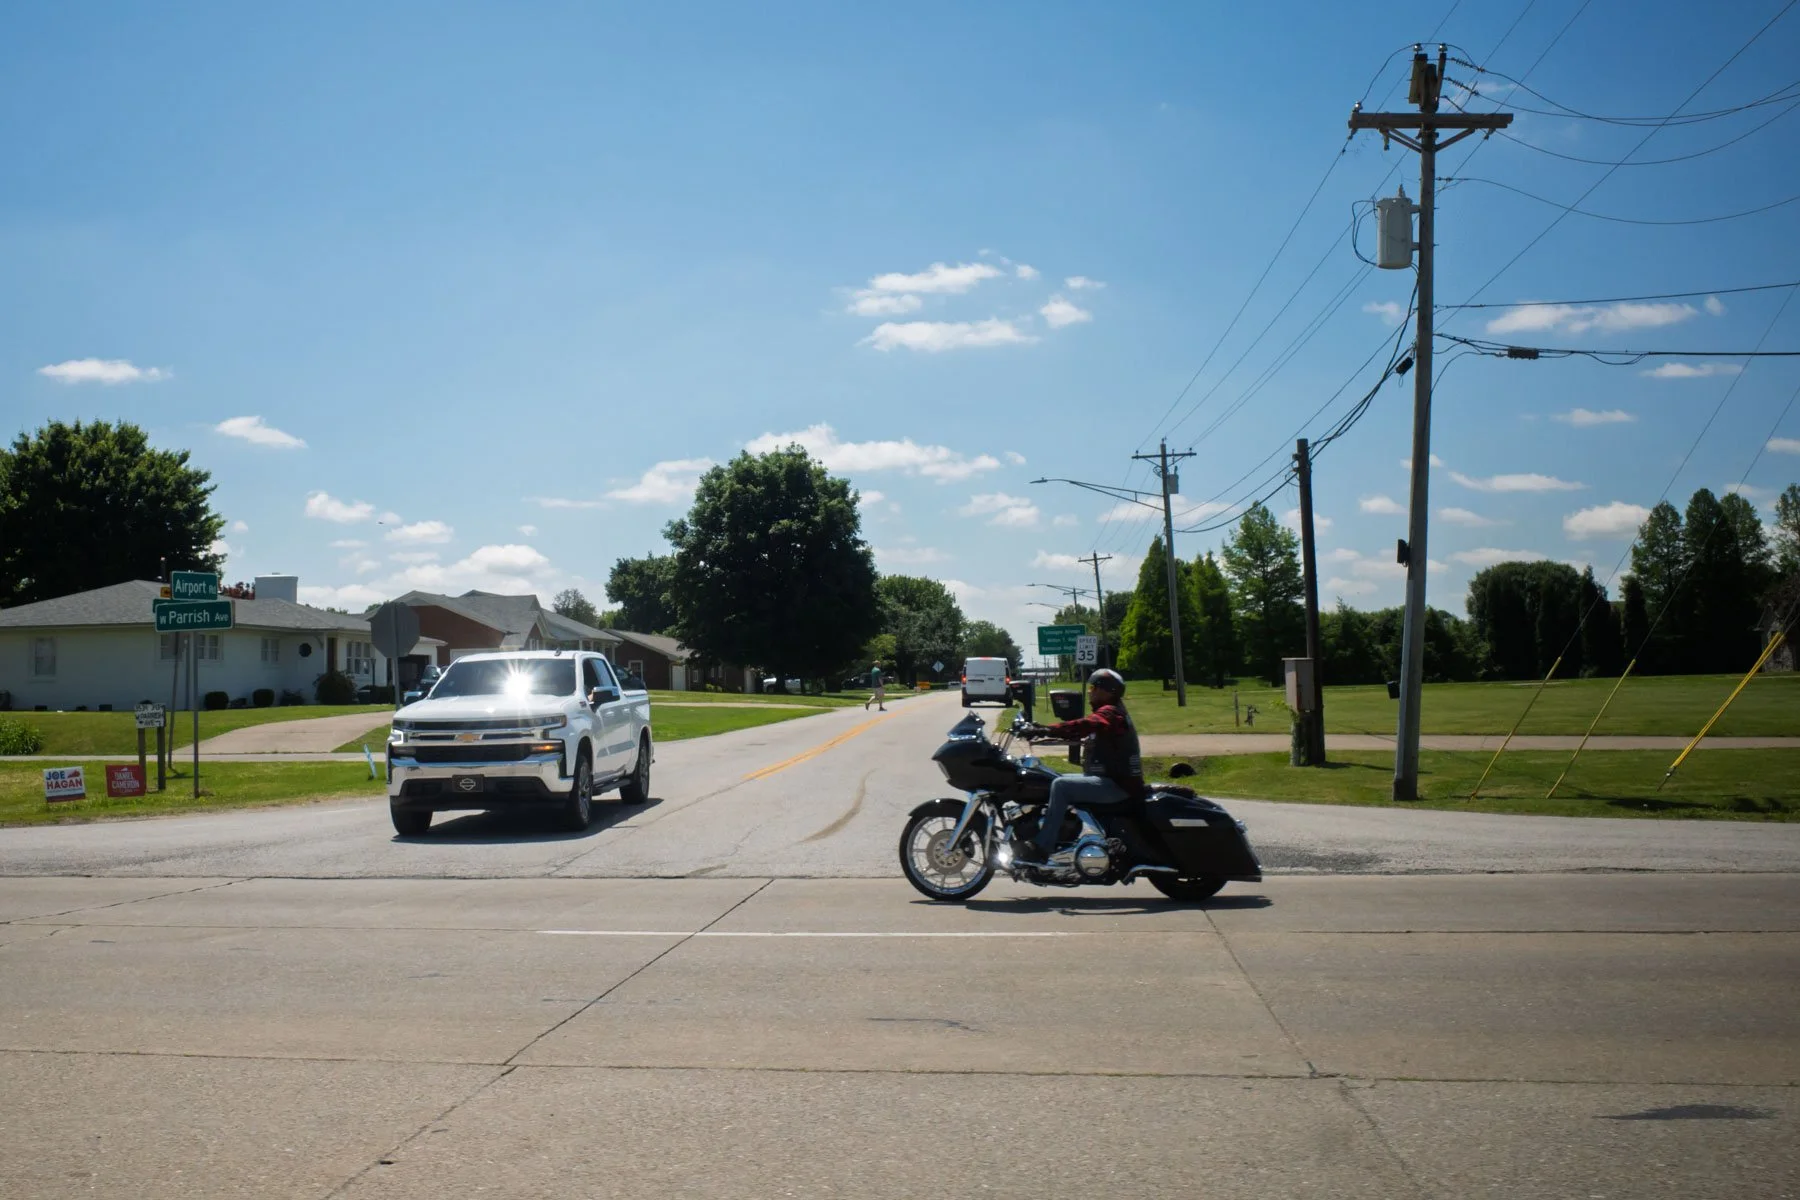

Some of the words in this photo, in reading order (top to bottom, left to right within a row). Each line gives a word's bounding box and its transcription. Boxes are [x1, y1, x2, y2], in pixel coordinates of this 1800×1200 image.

[175, 579, 206, 596] Airport
[208, 585, 216, 594] Rd
[160, 615, 166, 624] W
[168, 609, 210, 624] Parrish
[214, 612, 229, 622] Ave
[1078, 650, 1094, 661] 35
[46, 771, 65, 780] JOE
[46, 778, 83, 790] HAGAN
[111, 779, 139, 788] CAMERON
